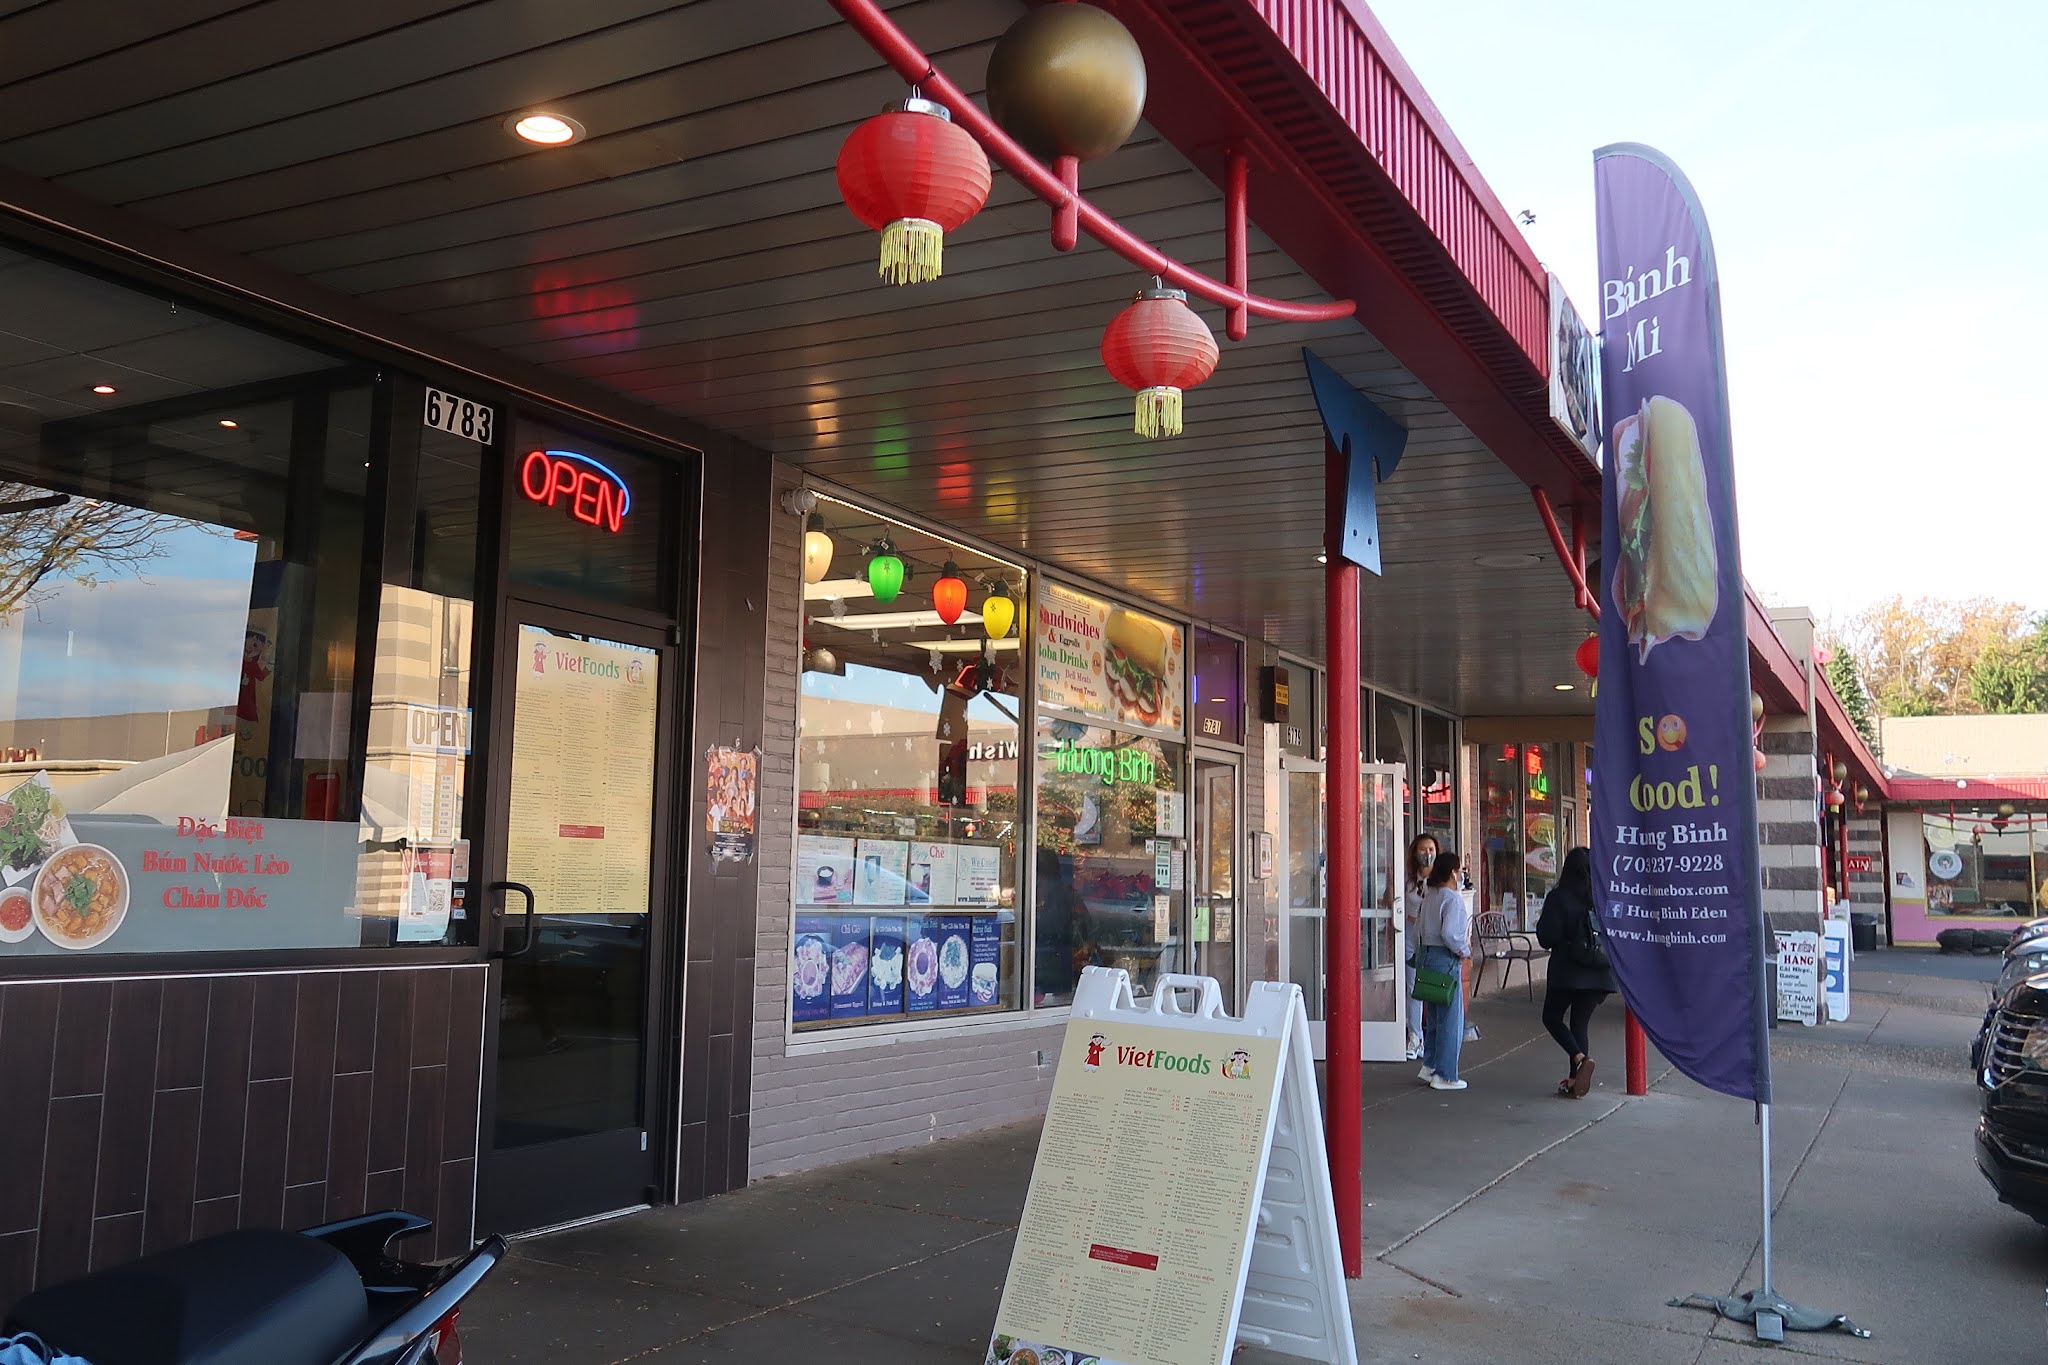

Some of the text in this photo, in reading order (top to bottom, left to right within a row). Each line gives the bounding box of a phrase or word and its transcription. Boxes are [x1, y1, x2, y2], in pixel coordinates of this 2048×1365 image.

[427, 390, 490, 442] 6783
[522, 450, 626, 533] OPEN
[1048, 628, 1056, 643] &
[555, 651, 620, 679] VietFoods
[1060, 648, 1089, 669] Drinks
[1041, 665, 1060, 684] Party
[412, 710, 466, 747] OPEN
[1204, 719, 1220, 734] 6781
[176, 816, 265, 845] Đặc Biệt
[1671, 821, 1728, 844] Binh
[142, 850, 290, 875] Bún Nước Lèo
[162, 886, 268, 909] Châu Đốc
[1661, 906, 1688, 919] Binh
[1691, 906, 1728, 919] Eden
[1116, 1045, 1211, 1075] VietFoods
